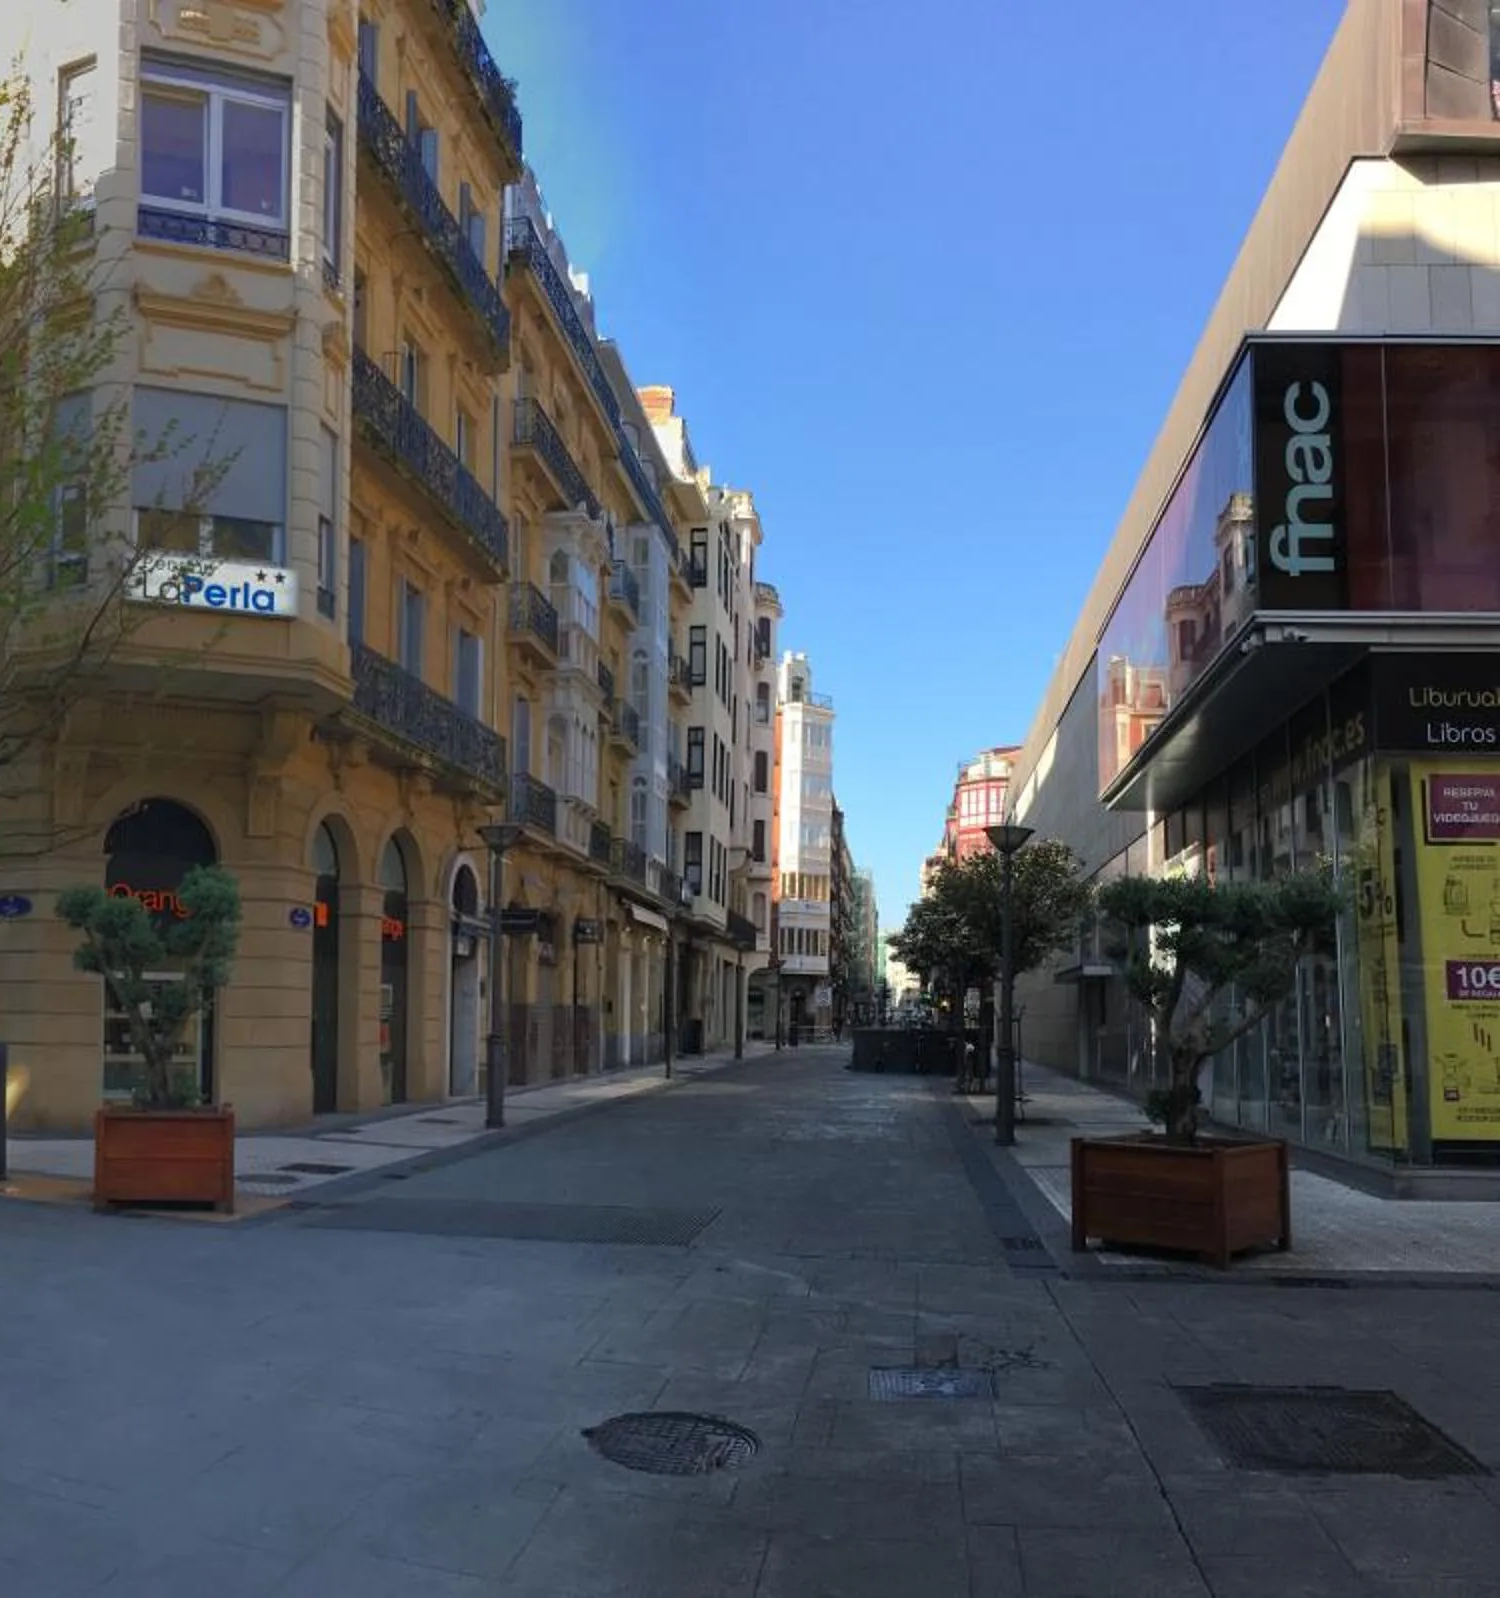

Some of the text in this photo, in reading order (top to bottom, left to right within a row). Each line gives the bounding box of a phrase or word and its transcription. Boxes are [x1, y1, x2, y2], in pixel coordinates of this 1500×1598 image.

[1269, 381, 1335, 577] fnac
[182, 574, 276, 613] Perla
[1408, 687, 1500, 708] Liburua
[1427, 722, 1496, 743] Libros
[1461, 801, 1479, 811] TU
[111, 882, 195, 919] Orang
[1456, 965, 1500, 989] 10€
